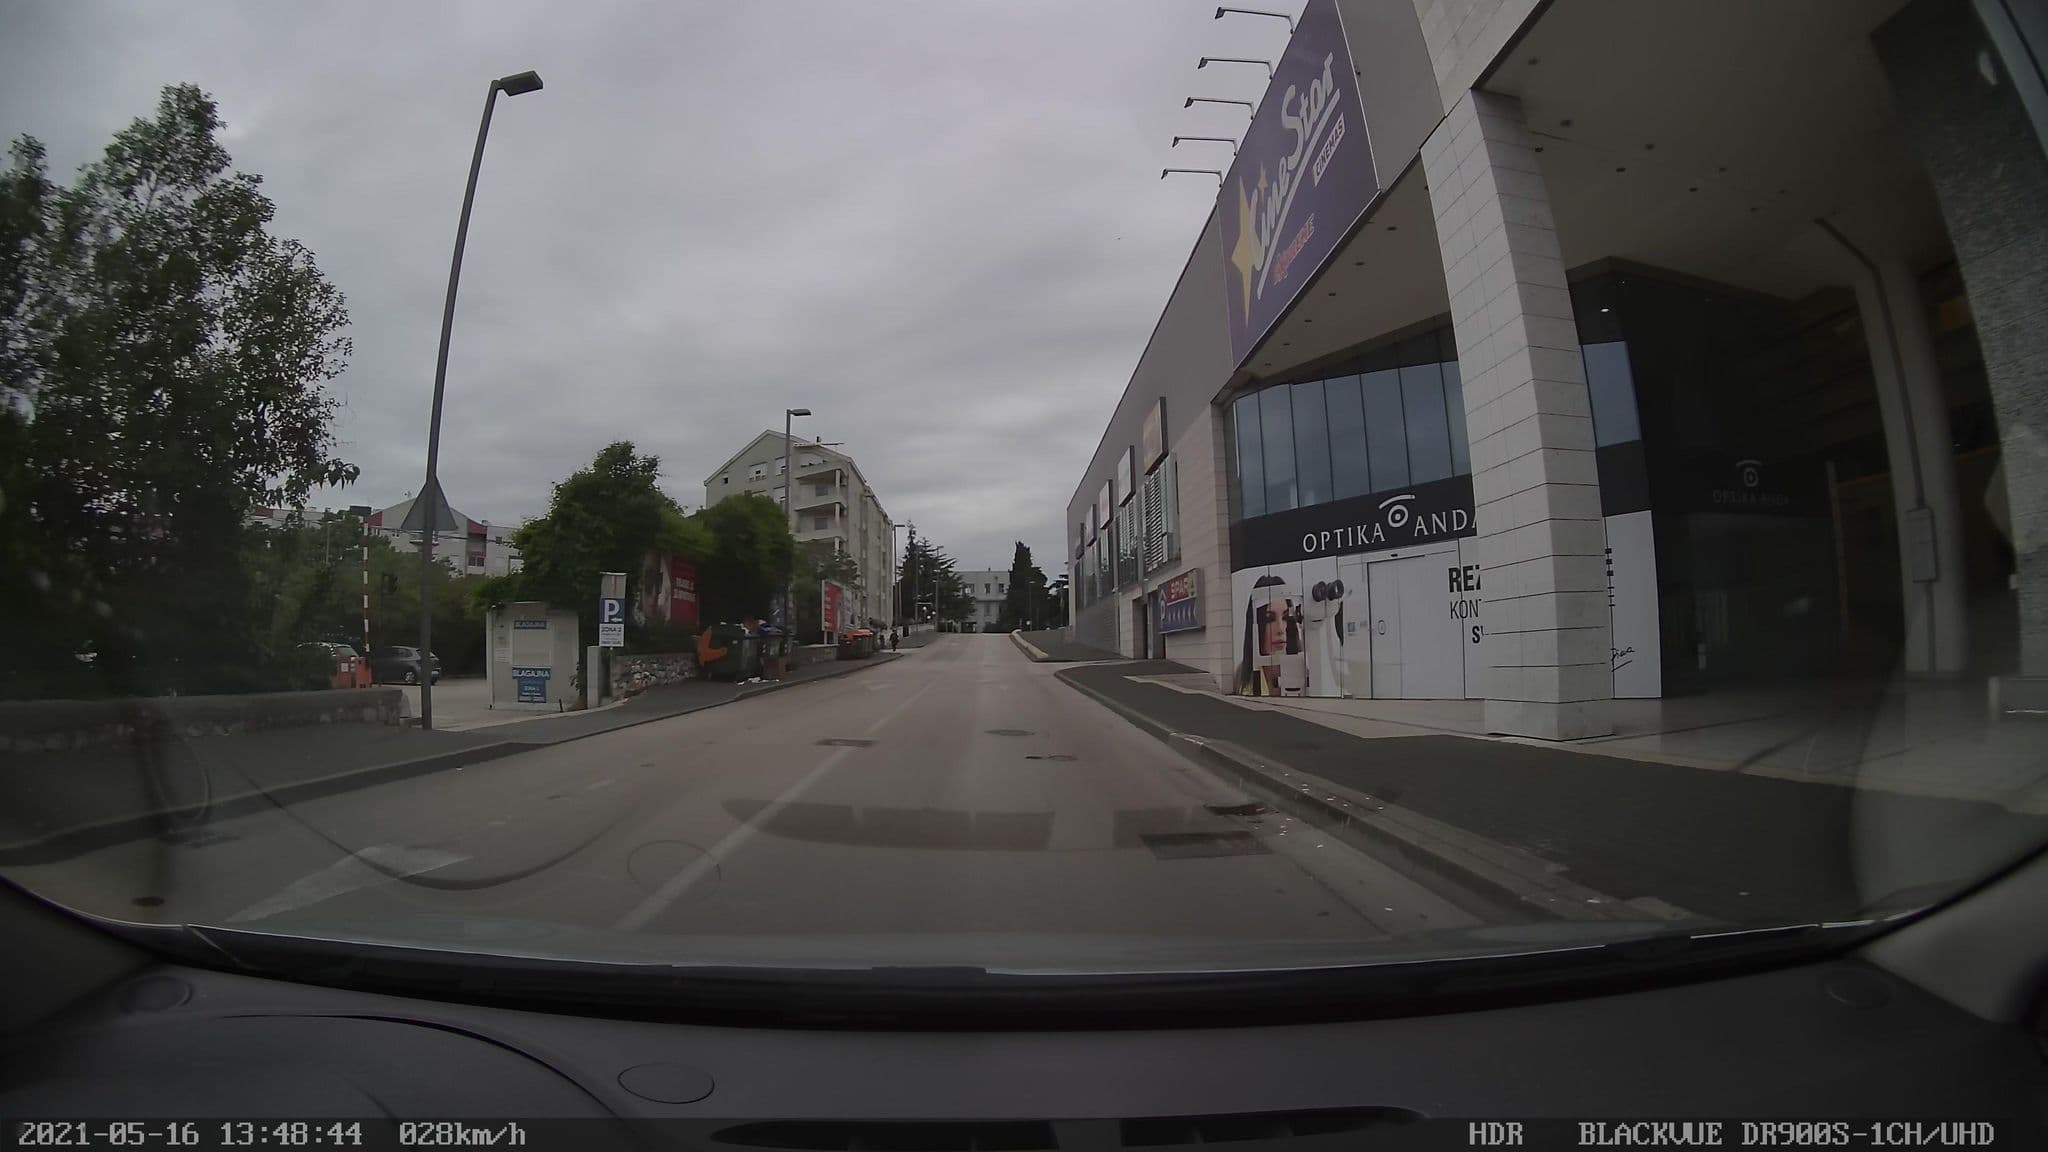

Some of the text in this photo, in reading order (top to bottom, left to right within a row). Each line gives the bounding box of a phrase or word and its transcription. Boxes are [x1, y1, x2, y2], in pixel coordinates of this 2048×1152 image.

[1316, 118, 1343, 178] CINEMAS
[1302, 522, 1385, 553] OPTIKA
[604, 599, 620, 622] P
[1449, 598, 1482, 619] KON
[512, 669, 549, 677] BLAGAJNA
